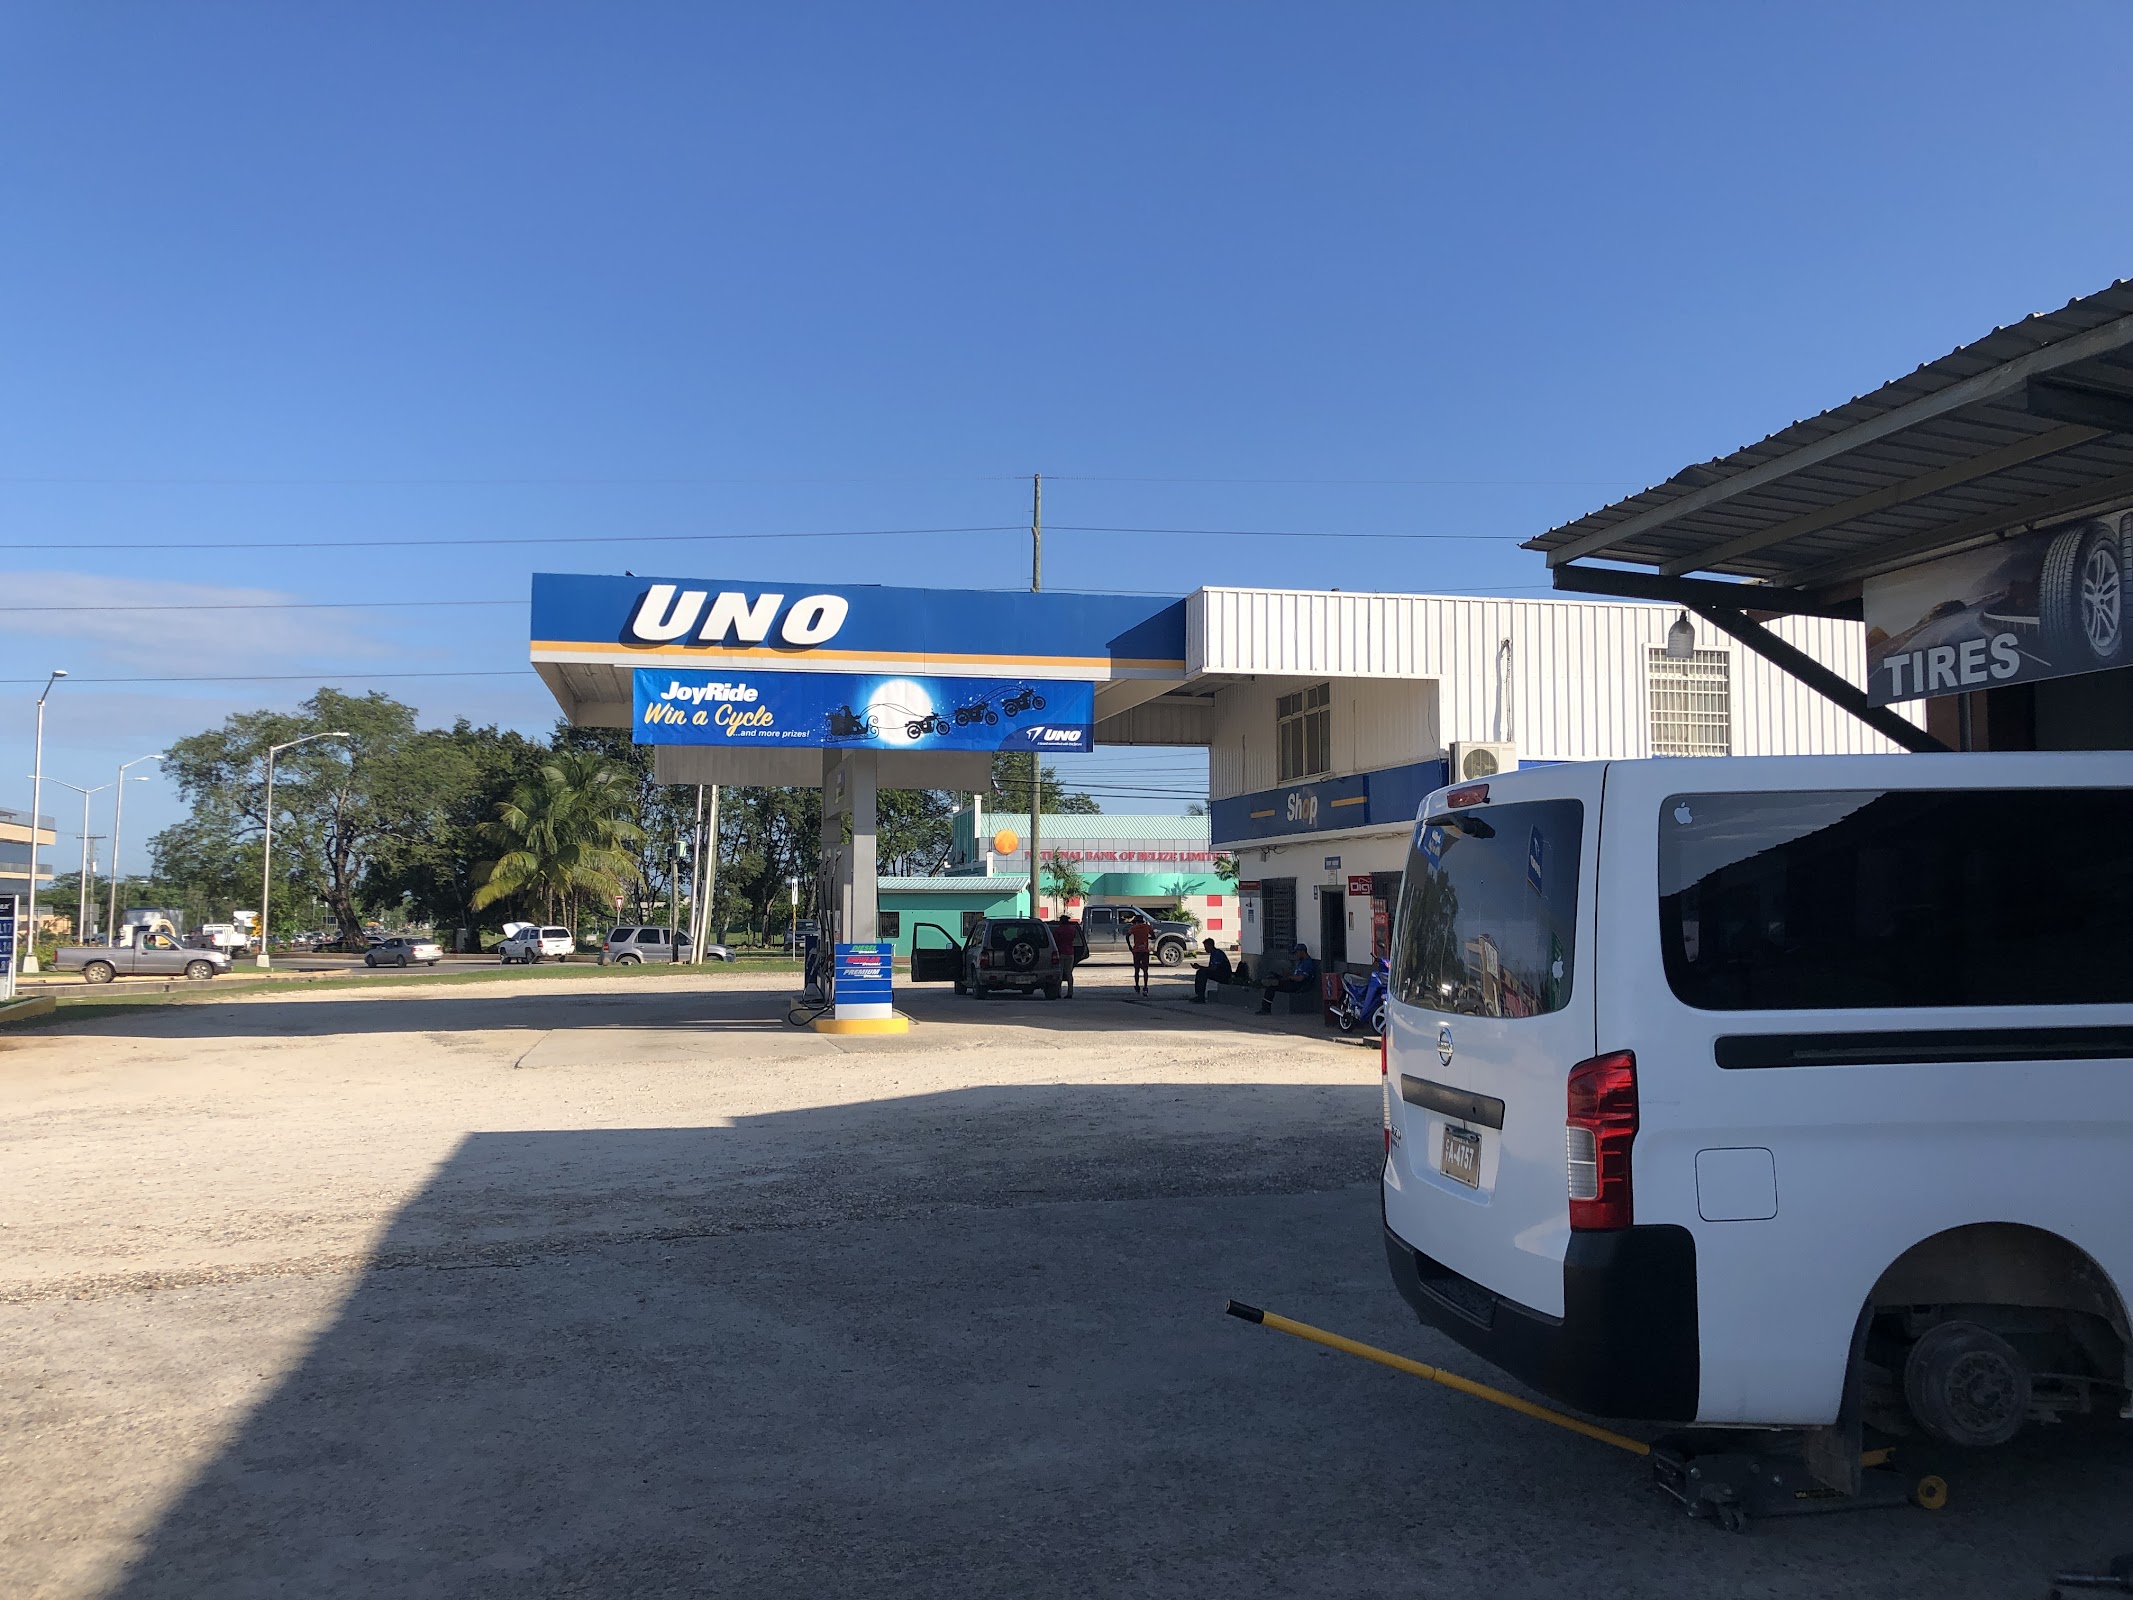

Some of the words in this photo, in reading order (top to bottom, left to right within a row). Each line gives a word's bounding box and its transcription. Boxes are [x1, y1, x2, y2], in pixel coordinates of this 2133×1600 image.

[632, 584, 849, 645] UNO
[1883, 632, 2020, 697] TIRES
[660, 681, 759, 705] JoyRide
[644, 702, 687, 725] Win
[692, 710, 708, 725] a
[714, 703, 774, 737] Cycle
[782, 730, 810, 738] prizes!
[1043, 729, 1082, 741] UNO
[1287, 792, 1318, 825] Shop
[1024, 851, 1084, 861] NTINAL
[1085, 851, 1118, 861] BANK
[1119, 851, 1136, 861] OF
[1137, 851, 1178, 862] BELIZE
